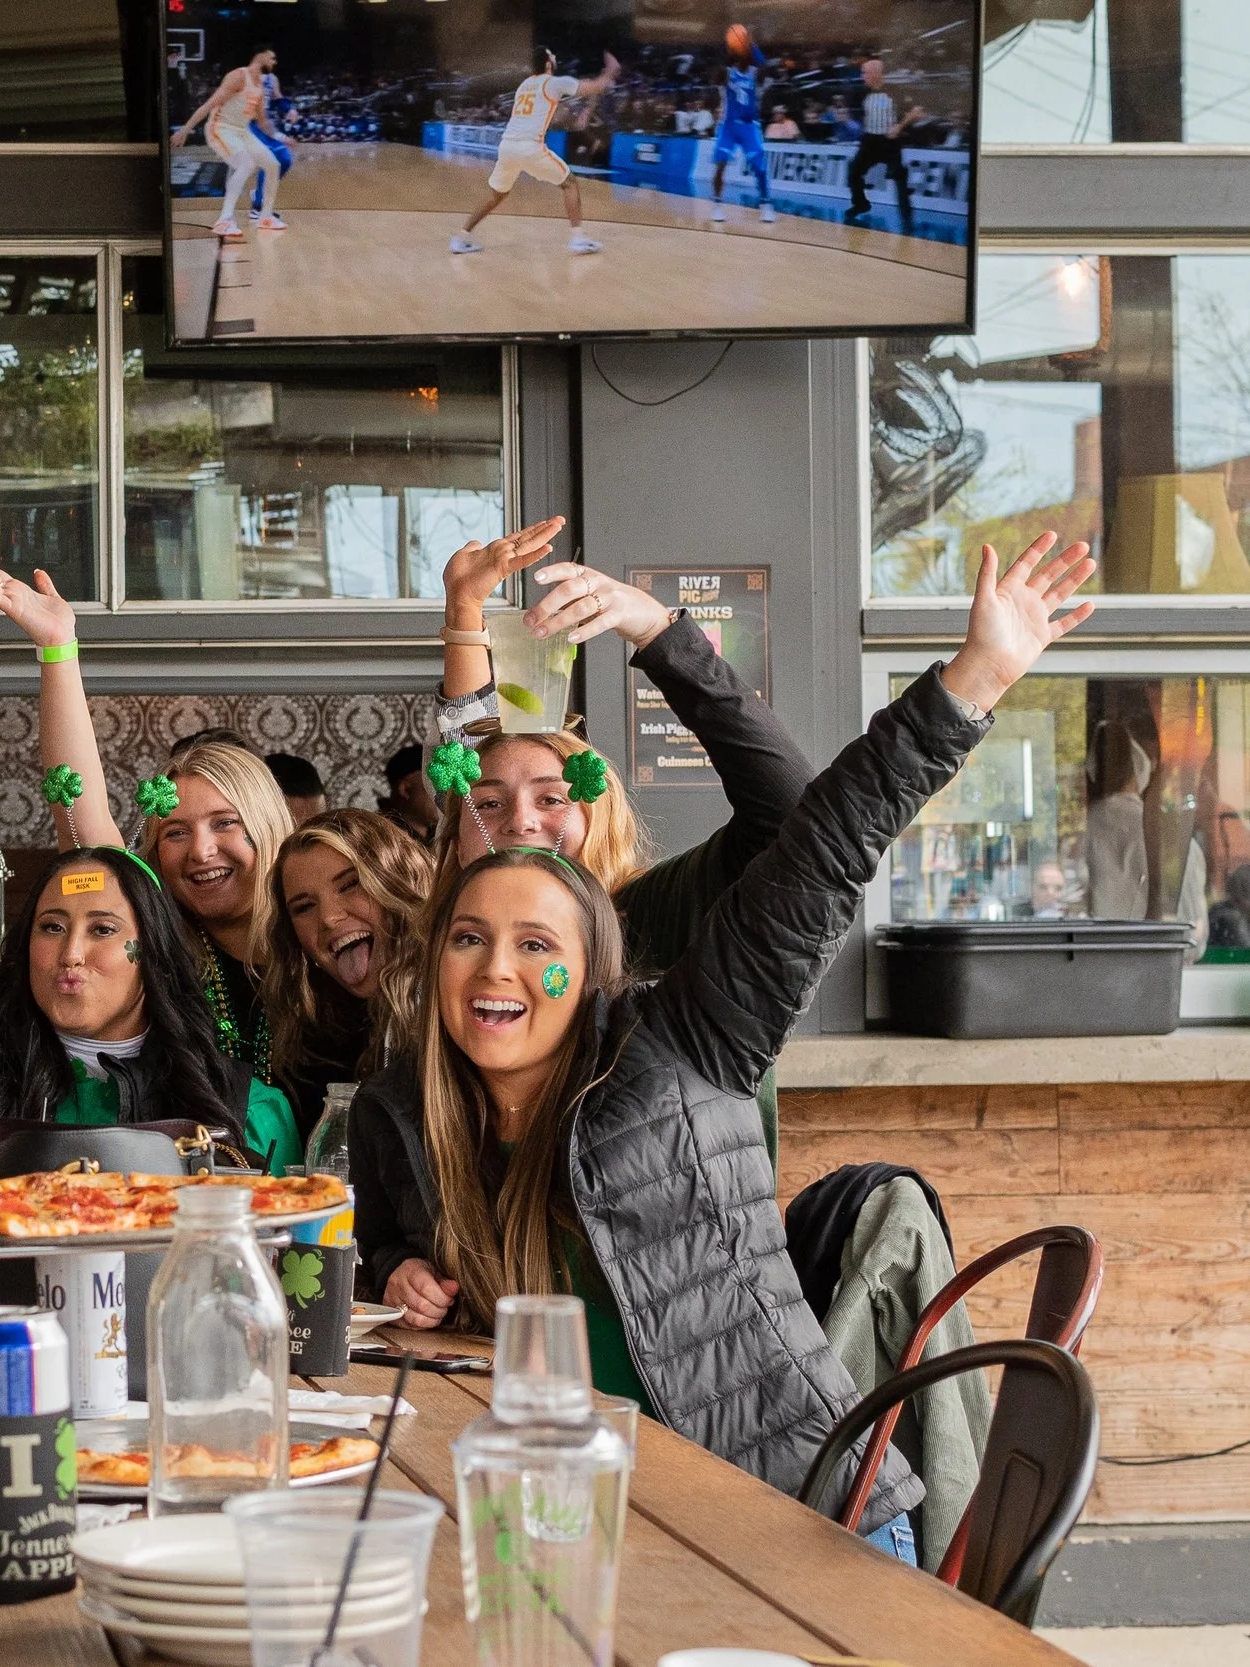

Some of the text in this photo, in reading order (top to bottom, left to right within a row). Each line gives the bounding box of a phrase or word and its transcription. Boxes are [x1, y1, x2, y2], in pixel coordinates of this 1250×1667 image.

[678, 590, 701, 604] PIG
[668, 606, 733, 620] INKS
[640, 723, 665, 735] Irish
[67, 877, 83, 885] HIGH
[37, 1274, 67, 1311] elo
[92, 1272, 125, 1310] Mo
[0, 1433, 43, 1498] I
